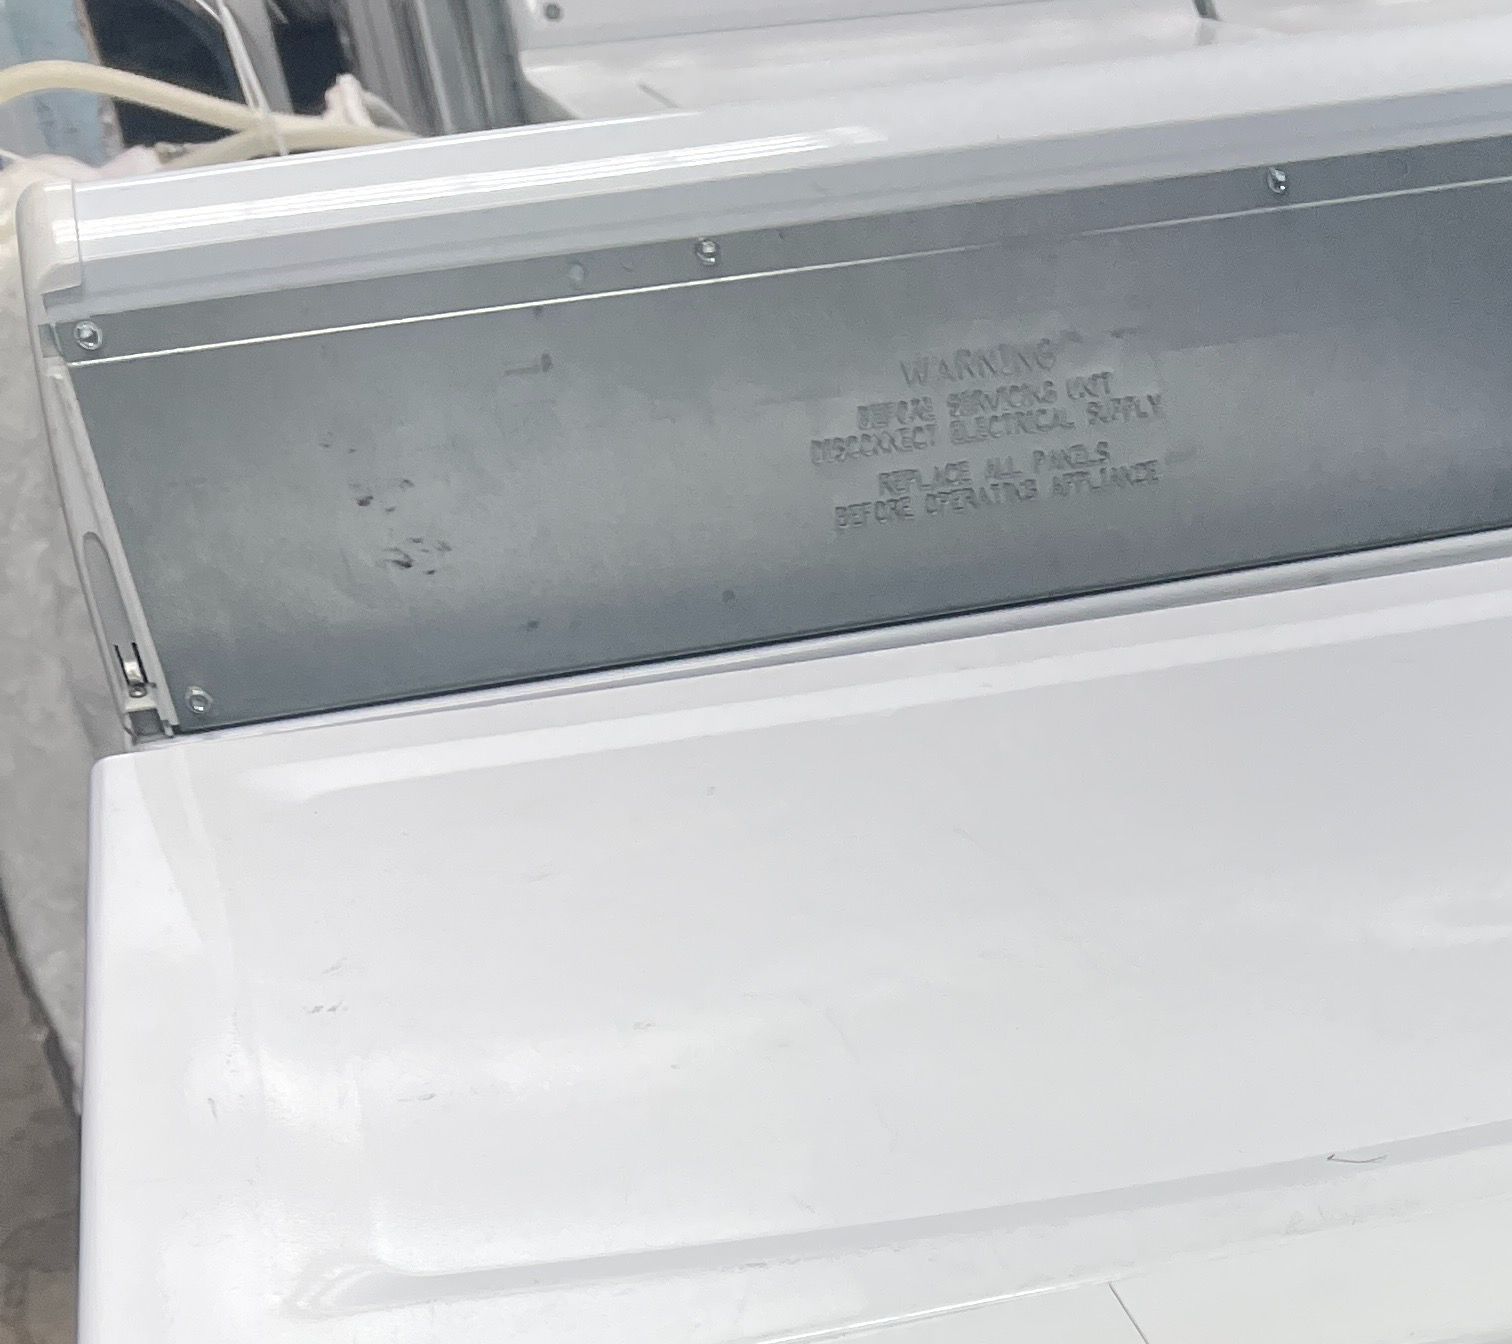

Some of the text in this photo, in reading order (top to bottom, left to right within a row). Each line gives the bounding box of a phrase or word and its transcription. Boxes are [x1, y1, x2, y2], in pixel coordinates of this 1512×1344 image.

[901, 338, 1057, 387] WARNING
[950, 408, 1074, 445] ELECTRICAL
[1087, 393, 1162, 426] SUPPLY
[834, 460, 1159, 529] BEFORE OPERATING APPLIANCE
[879, 442, 1110, 496] REPLACE ALL PANELS
